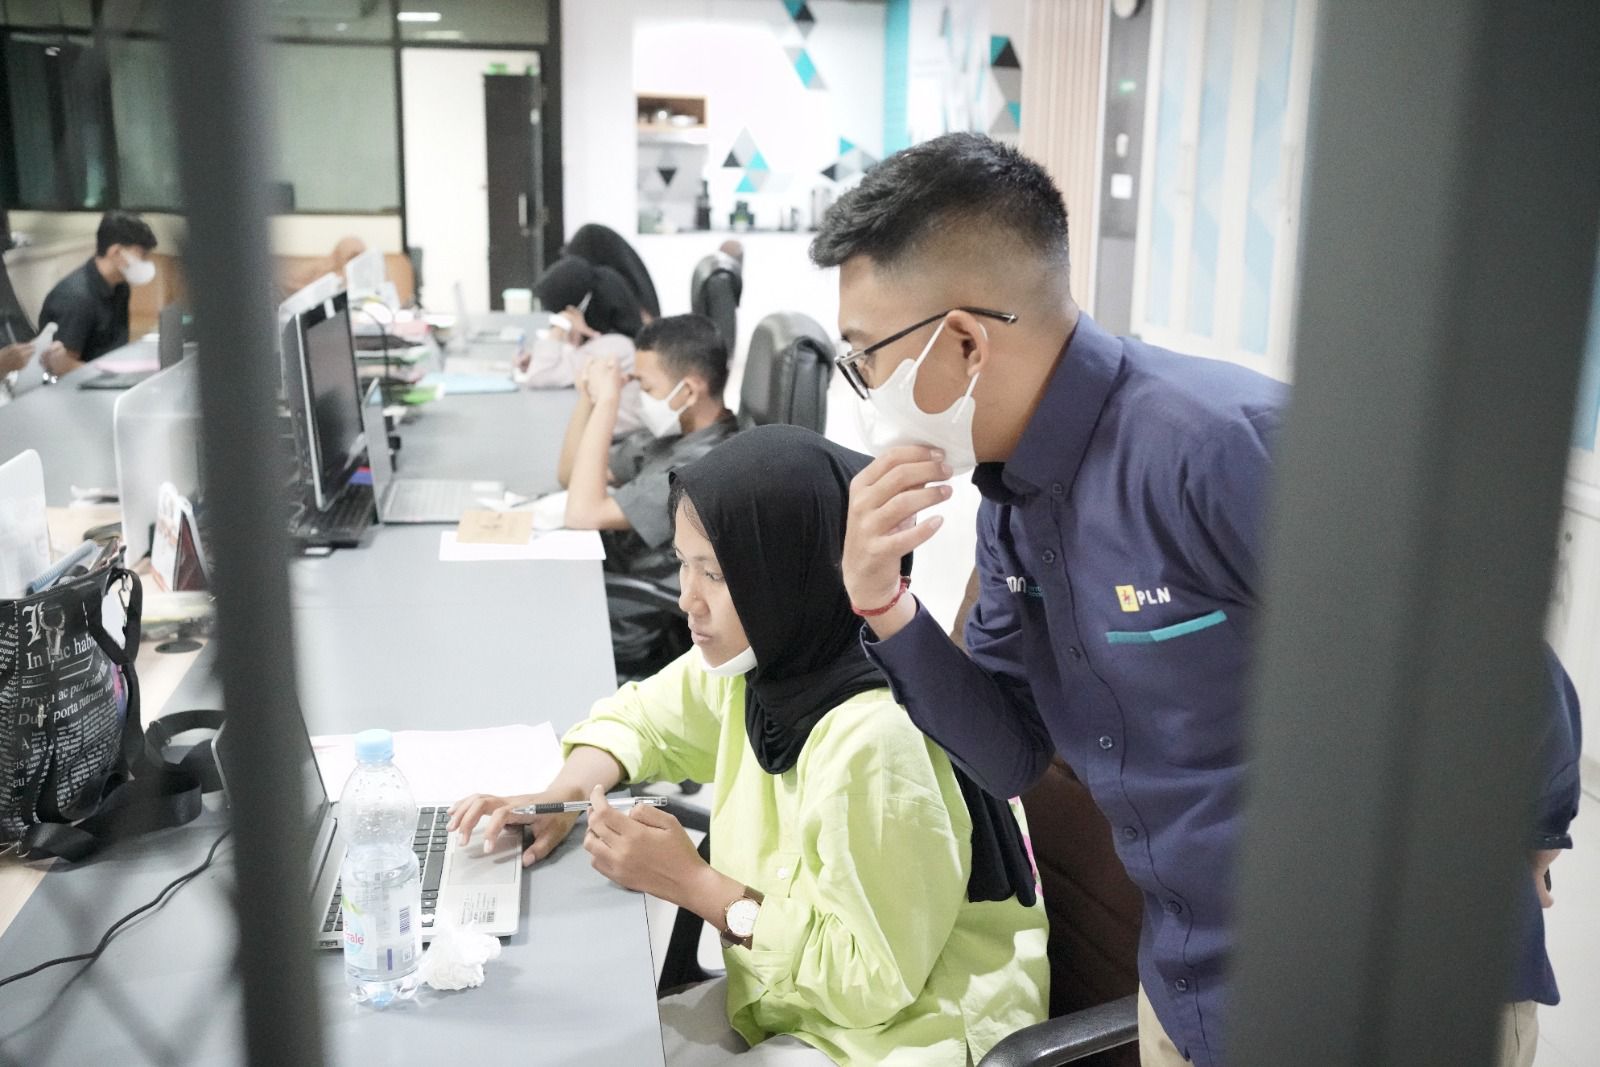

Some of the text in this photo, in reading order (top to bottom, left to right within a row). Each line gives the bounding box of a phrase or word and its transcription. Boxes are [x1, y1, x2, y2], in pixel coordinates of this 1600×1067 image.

[1136, 586, 1172, 606] PLN
[26, 652, 44, 670] In
[53, 702, 79, 723] porta
